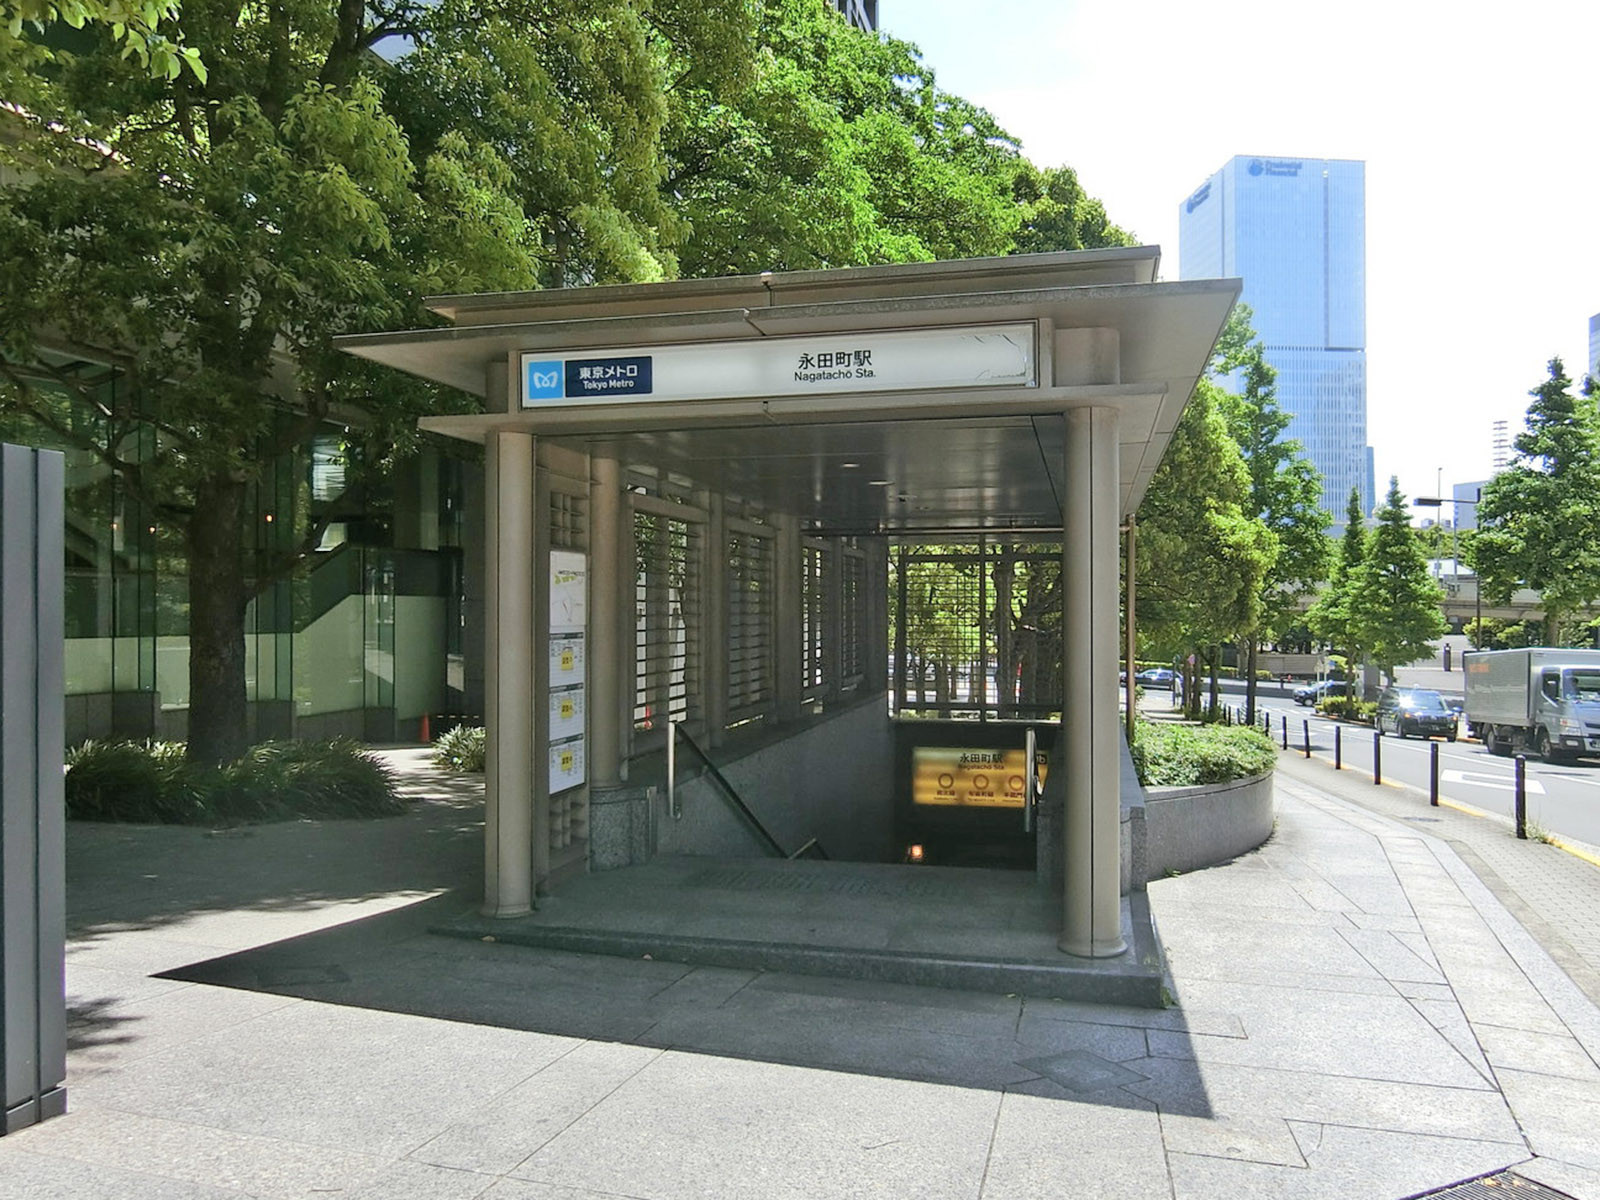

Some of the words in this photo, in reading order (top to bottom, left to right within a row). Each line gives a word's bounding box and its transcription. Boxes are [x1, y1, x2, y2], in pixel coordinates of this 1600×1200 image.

[798, 349, 872, 370] 永田町駅
[579, 364, 638, 380] 東京メトロ
[855, 367, 876, 379] Sta.
[583, 380, 608, 391] Tokyo
[609, 379, 635, 389] Metro
[959, 752, 1004, 764] 永田町駅
